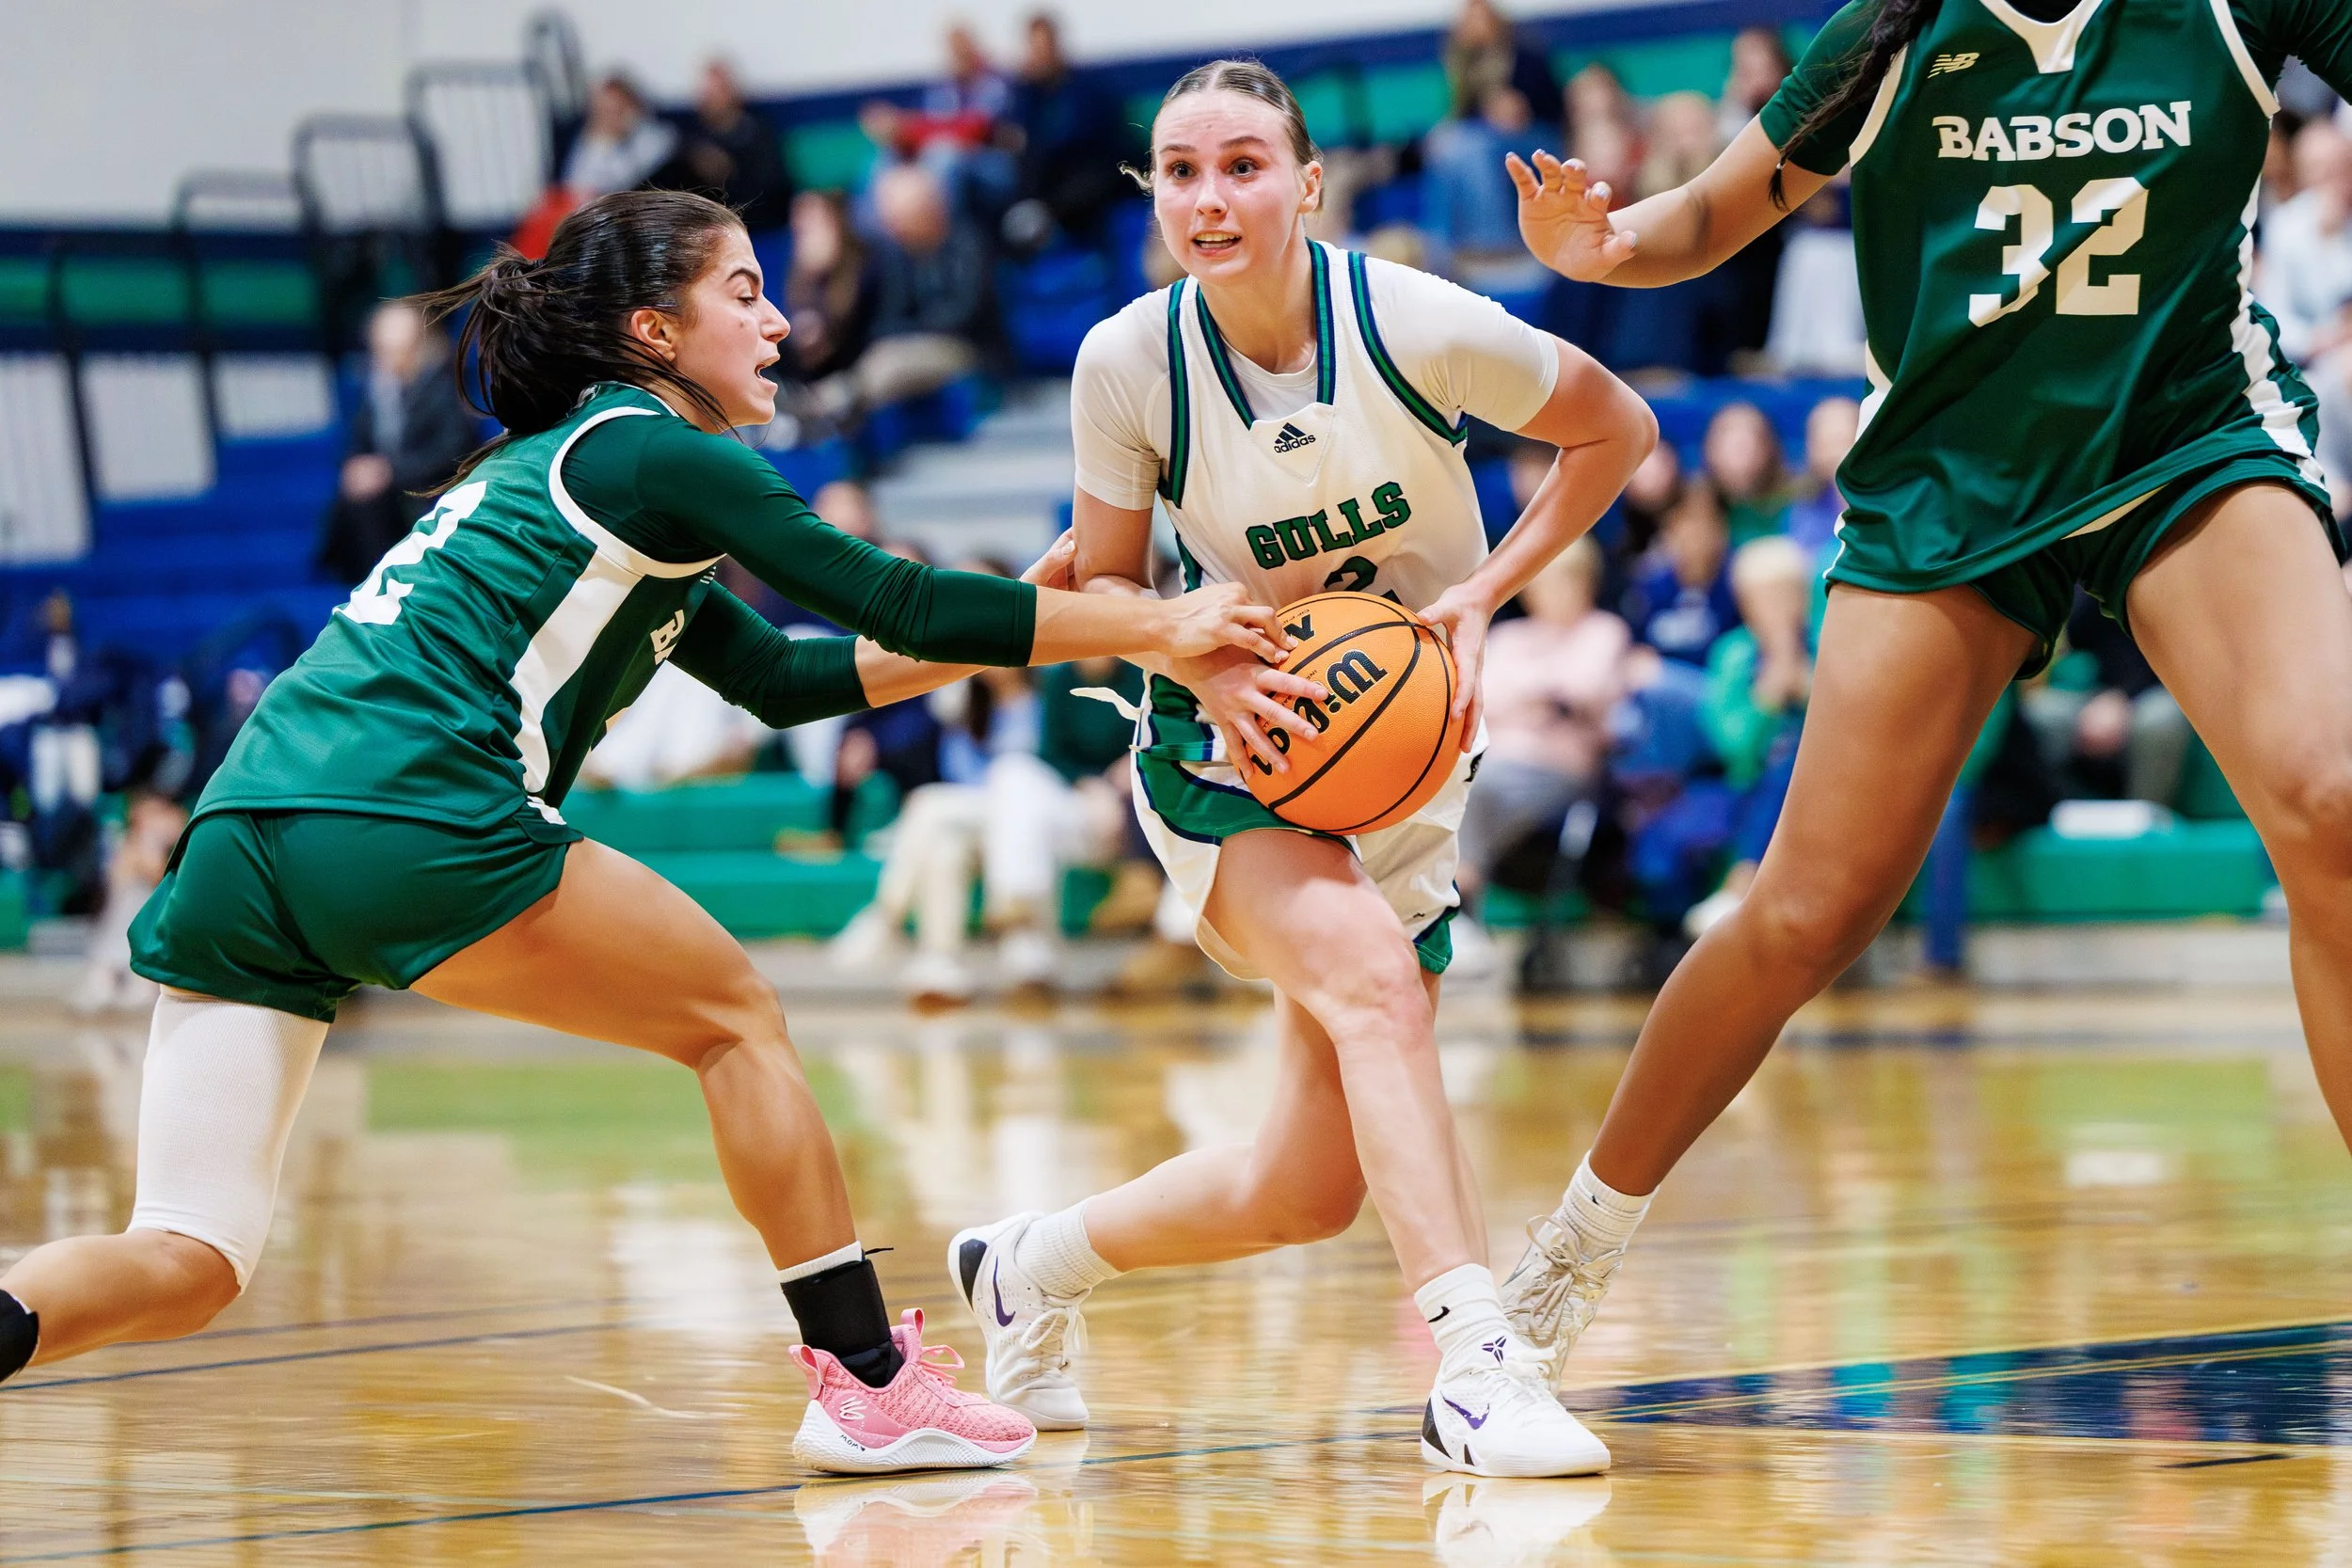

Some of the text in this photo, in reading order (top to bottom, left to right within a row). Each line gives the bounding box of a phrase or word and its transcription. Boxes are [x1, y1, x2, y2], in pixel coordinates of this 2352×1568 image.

[1931, 100, 2192, 162] BABSON
[1968, 176, 2150, 327] 32
[1273, 434, 1316, 453] adidas
[1245, 481, 1412, 570] GULLS
